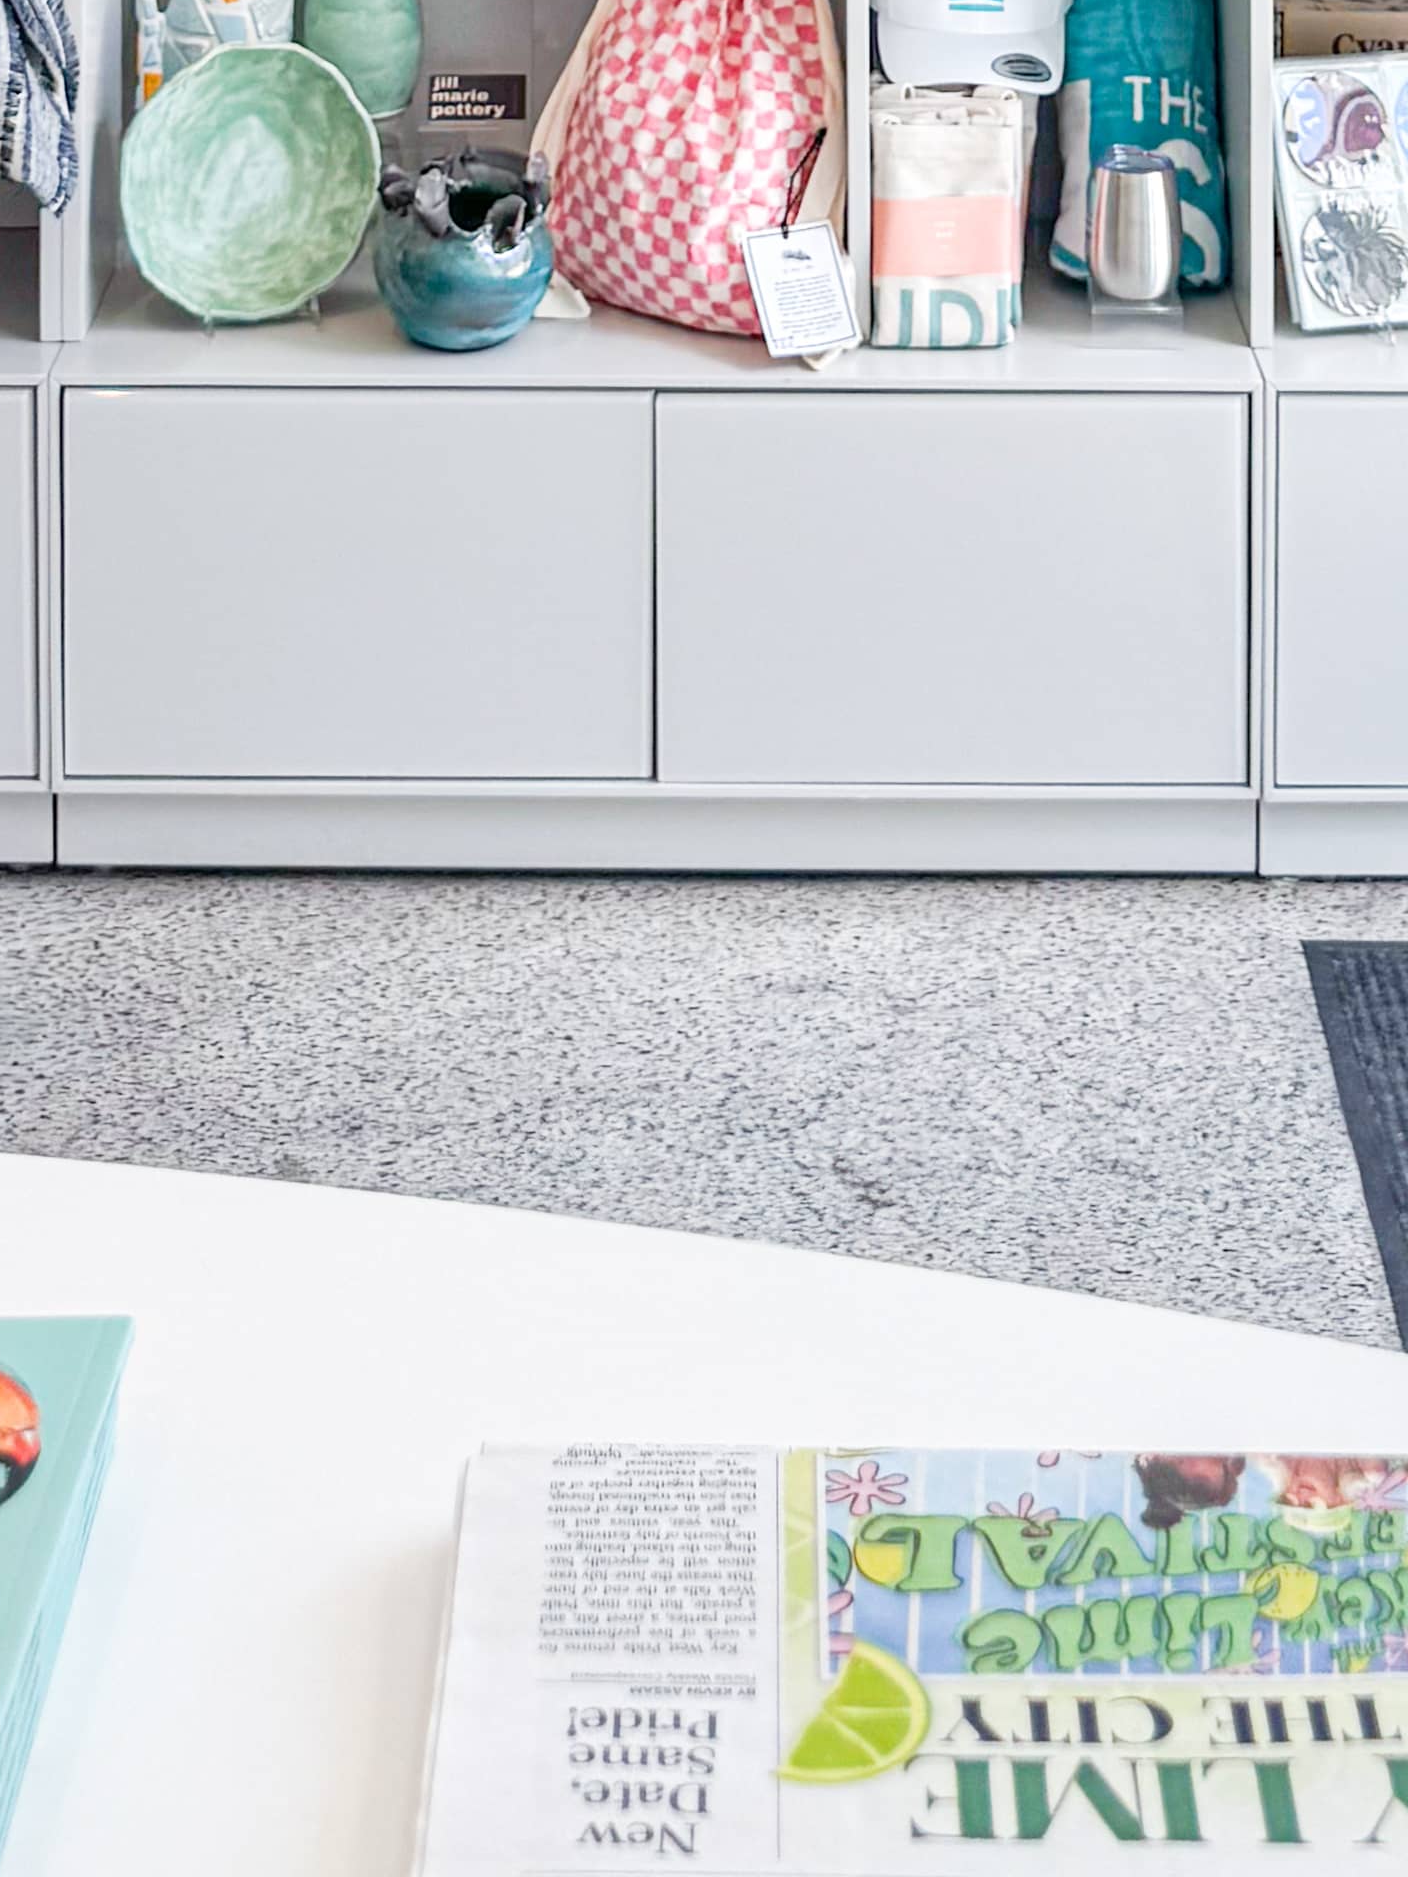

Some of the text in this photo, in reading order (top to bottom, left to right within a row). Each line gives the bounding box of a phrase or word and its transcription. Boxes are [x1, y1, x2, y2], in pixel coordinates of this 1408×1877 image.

[431, 89, 489, 102] marie
[432, 76, 459, 92] jill
[430, 104, 505, 120] pottery
[1123, 76, 1208, 133] THE
[964, 1591, 1258, 1676] Lime
[567, 1707, 719, 1739] Pride!
[936, 1695, 1174, 1745] CITY
[1208, 1694, 1401, 1744] THE
[568, 1745, 715, 1776] Same
[571, 1781, 712, 1814] Date,
[903, 1754, 1302, 1844] LIME
[576, 1821, 698, 1856] New
